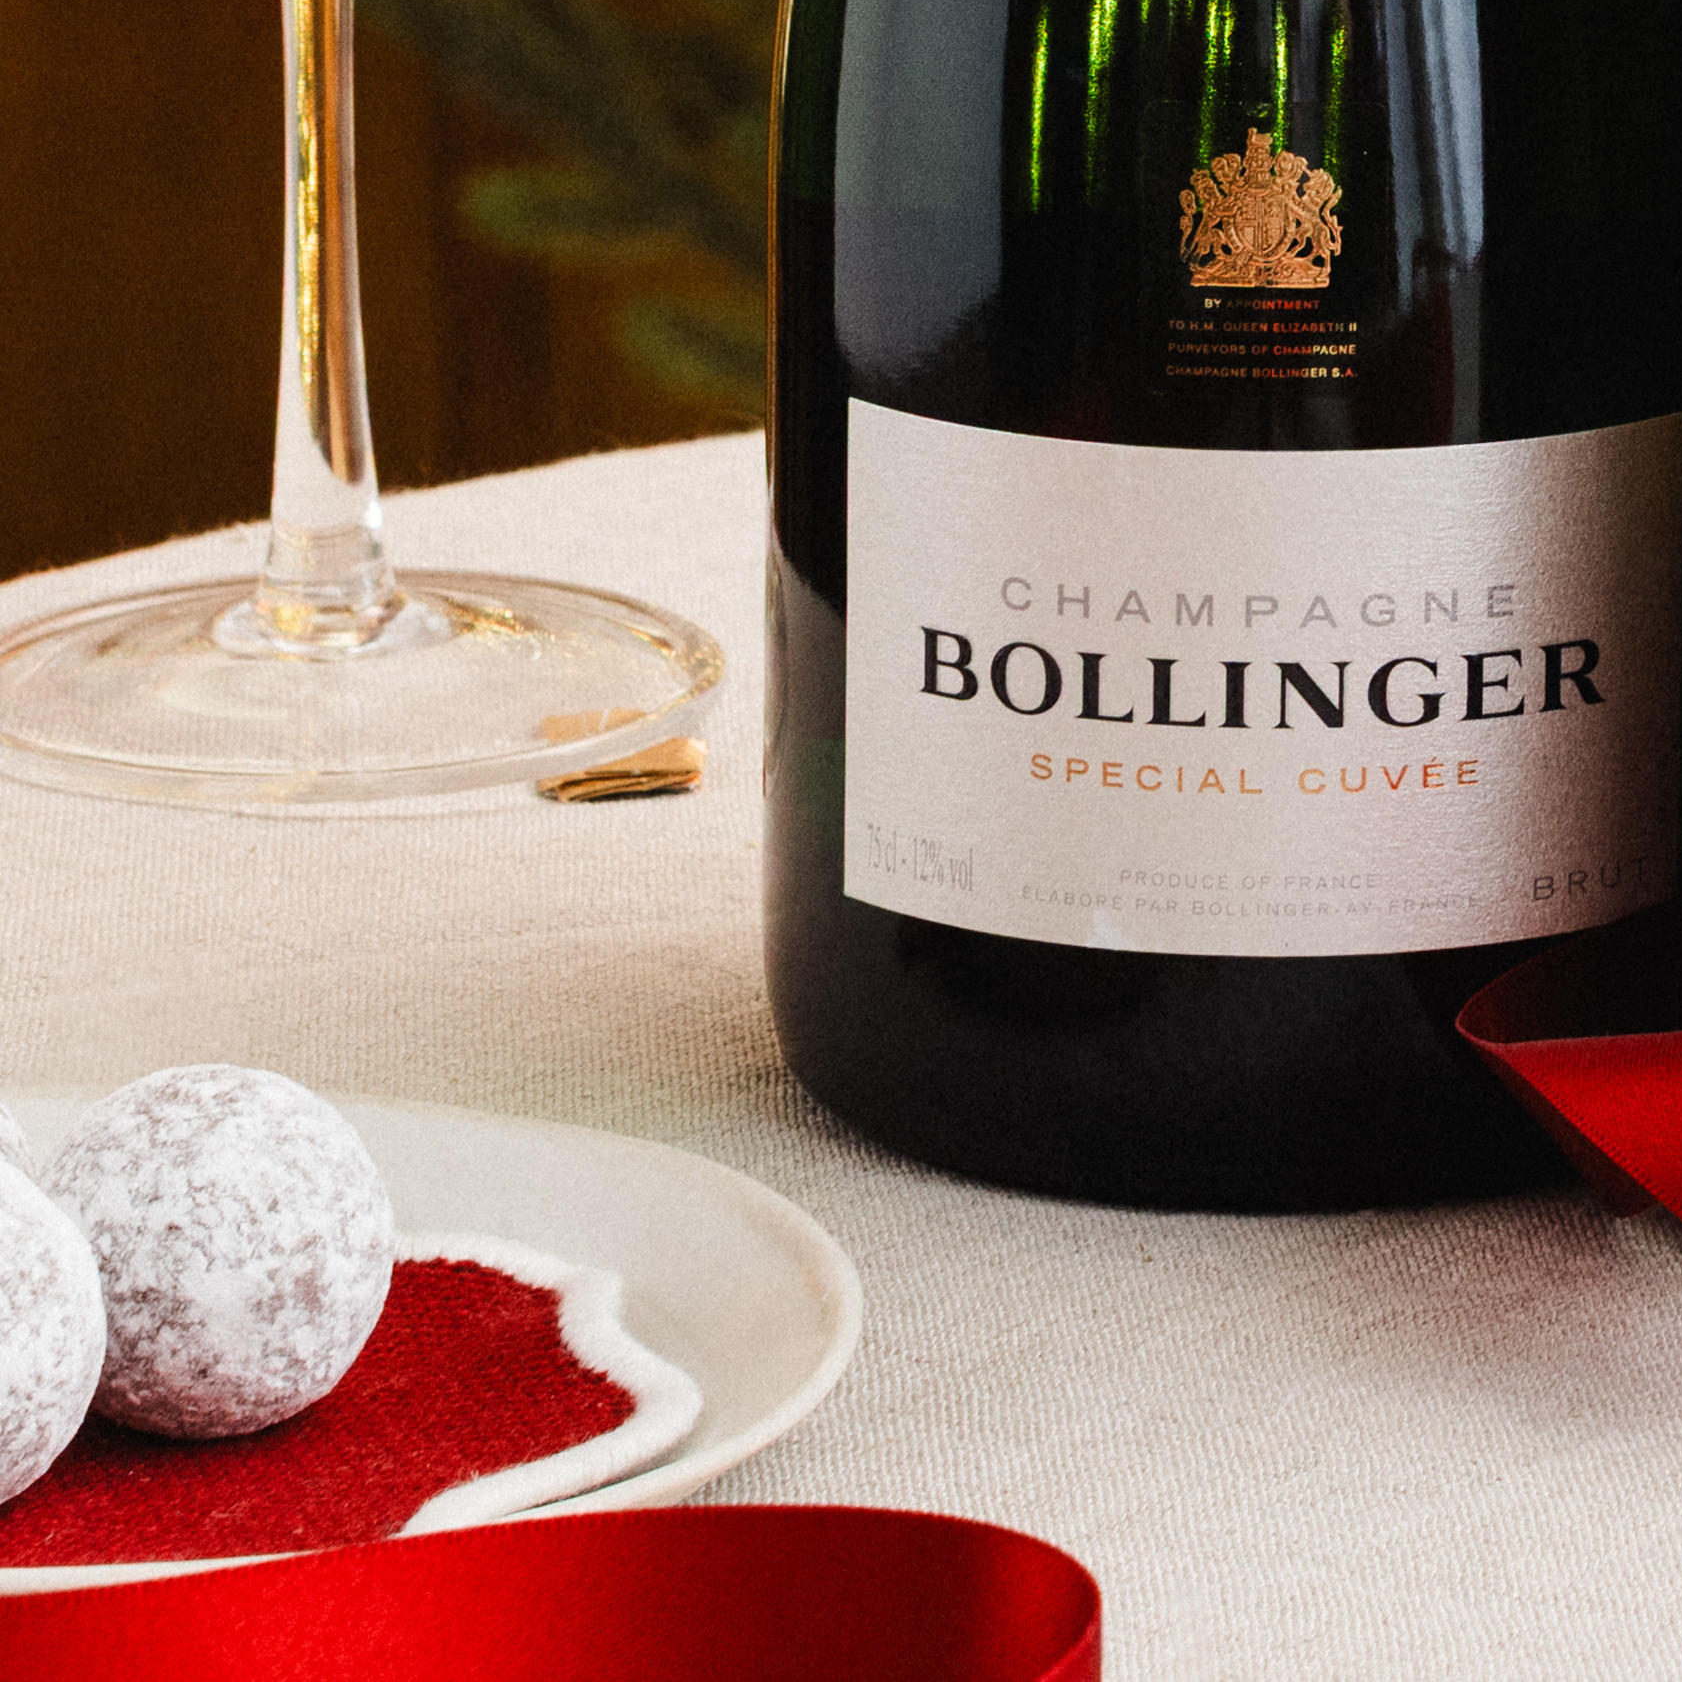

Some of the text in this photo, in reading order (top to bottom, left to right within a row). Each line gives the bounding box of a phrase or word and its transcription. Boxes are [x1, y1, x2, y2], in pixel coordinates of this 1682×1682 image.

[1204, 298, 1221, 309] BY
[1273, 344, 1357, 355] CHAMPAGNE
[1252, 367, 1327, 379] BOLLINGER
[1001, 576, 1518, 630] CHAMPAGNE
[919, 626, 1606, 730] BOLLINGER
[1030, 753, 1481, 796] SPECIAL CUVÉE
[949, 847, 973, 892] vol
[1119, 869, 1381, 891] PRODUCE OF FRANCE
[1533, 855, 1649, 902] BRUT
[1022, 884, 1123, 911] ÉLABORÉ
[1135, 897, 1178, 914] PAR
